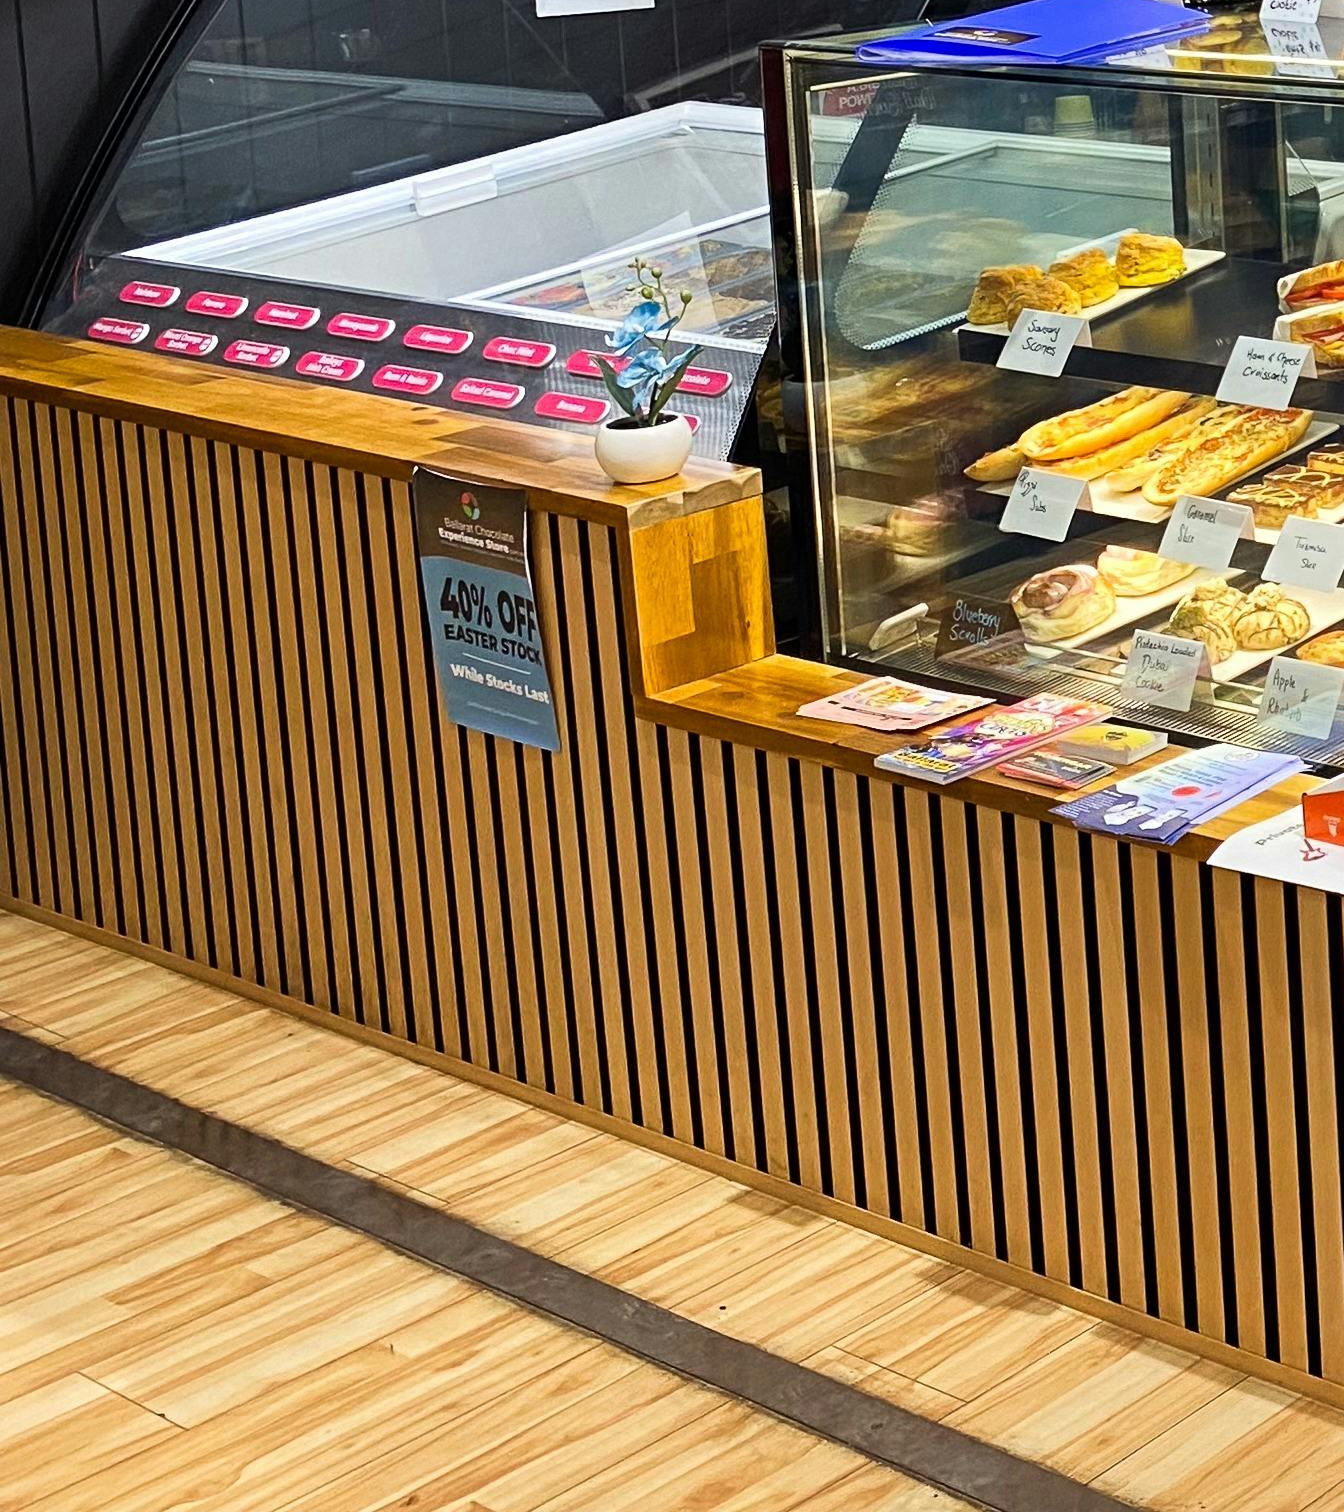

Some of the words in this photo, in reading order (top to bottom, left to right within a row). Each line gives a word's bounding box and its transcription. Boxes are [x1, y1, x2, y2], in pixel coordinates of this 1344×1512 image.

[440, 577, 493, 629] 40%
[497, 590, 536, 643] OFF
[952, 599, 1002, 635] Blueberry
[444, 624, 499, 653] EASTER
[501, 639, 542, 666] STOCK
[949, 623, 990, 646] Scrolls
[450, 663, 484, 685] While
[486, 673, 523, 696] Stocks
[525, 684, 550, 705] Last
[1273, 669, 1296, 689] Apple
